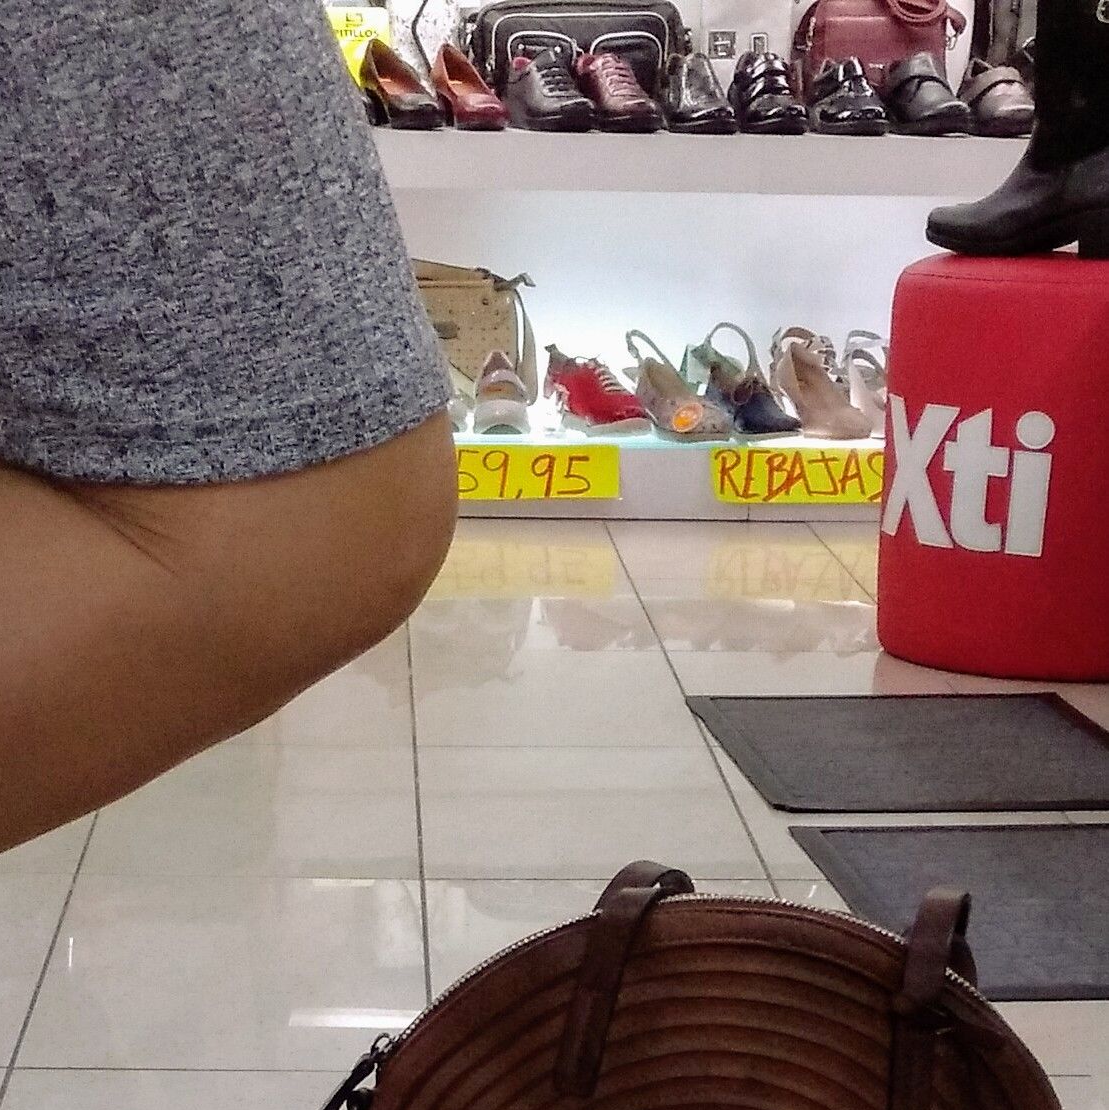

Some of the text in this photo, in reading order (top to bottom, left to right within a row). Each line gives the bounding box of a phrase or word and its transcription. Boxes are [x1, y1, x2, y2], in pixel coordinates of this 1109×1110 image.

[458, 450, 591, 499] 59,95
[714, 448, 884, 502] REBAJAS
[882, 393, 1056, 557] Xti
